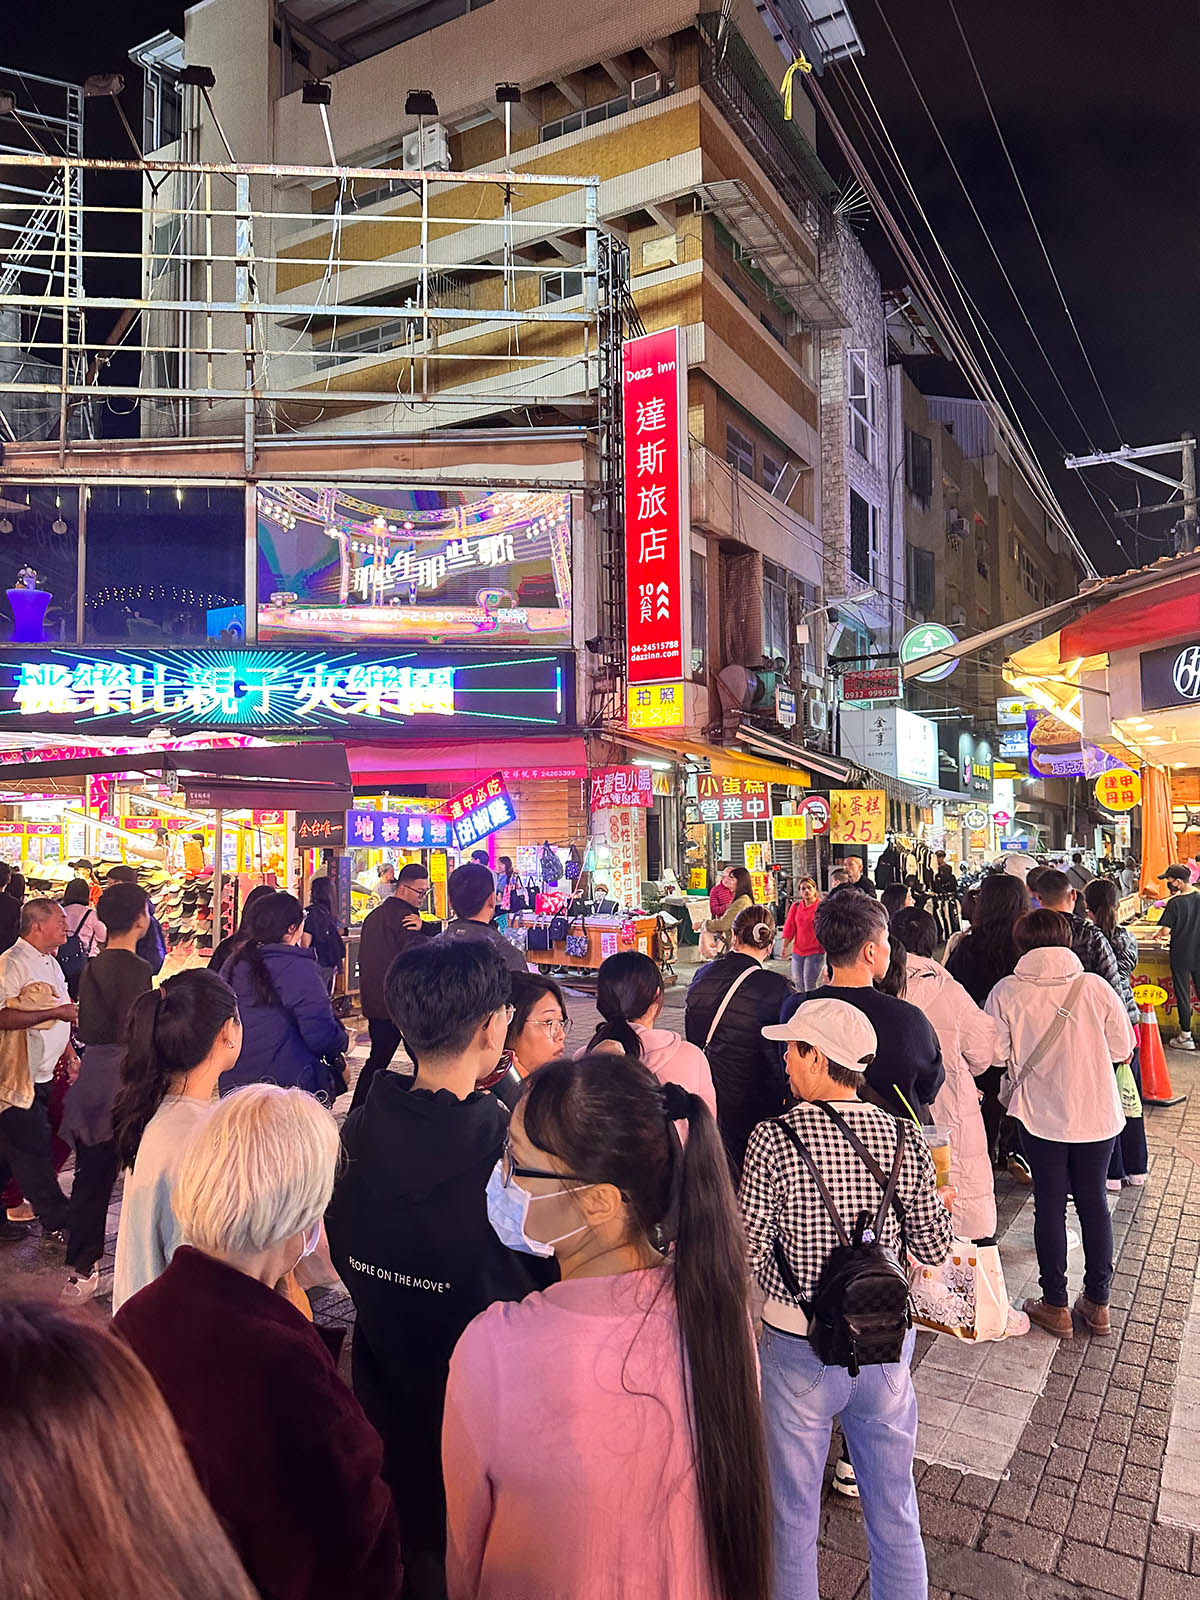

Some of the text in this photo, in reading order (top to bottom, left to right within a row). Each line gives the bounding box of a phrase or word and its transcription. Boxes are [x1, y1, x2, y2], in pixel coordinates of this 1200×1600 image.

[626, 360, 676, 383] Dazz inn
[636, 396, 668, 564] 達斯旅店
[631, 640, 679, 653] 04-24515788
[631, 649, 679, 662] dazzinn.com
[636, 687, 676, 706] 拍照
[450, 778, 502, 820] 逢甲必吃
[700, 796, 765, 820] 營業中
[833, 795, 882, 817] 小蛋糕
[354, 815, 447, 844] 地表最強
[842, 819, 872, 842] 25
[349, 1255, 375, 1276] PEOPLE
[376, 1268, 392, 1282] ON
[394, 1272, 411, 1287] THE
